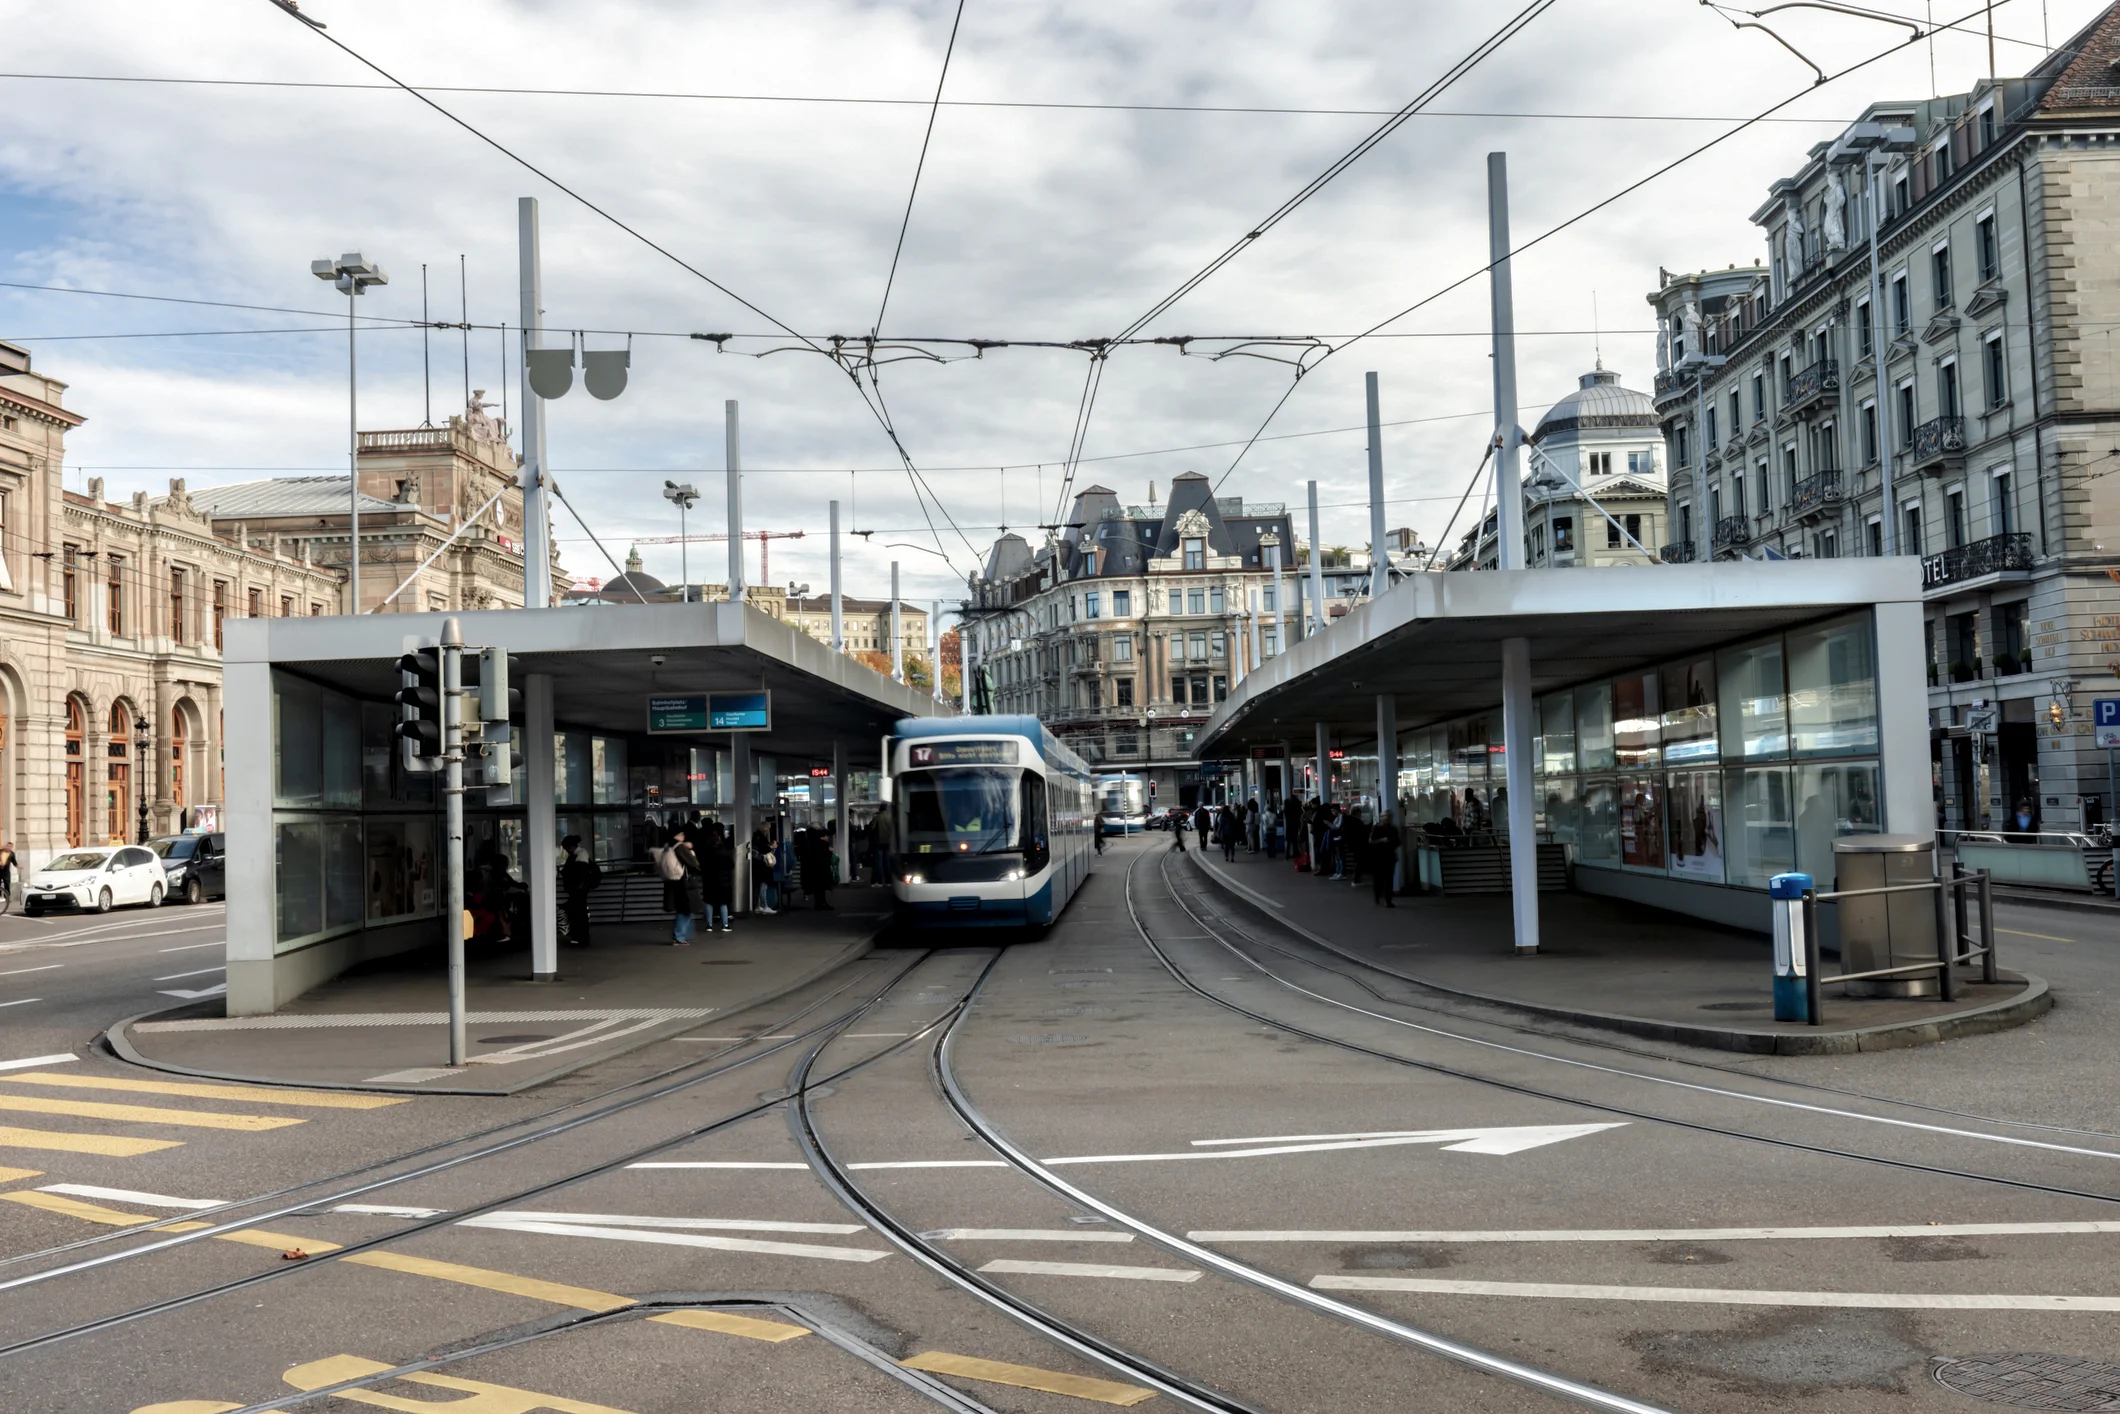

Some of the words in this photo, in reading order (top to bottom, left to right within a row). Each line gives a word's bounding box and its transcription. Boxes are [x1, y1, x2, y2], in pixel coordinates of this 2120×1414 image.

[2102, 702, 2115, 724] P
[658, 718, 665, 727] 3
[715, 717, 724, 725] 14
[915, 748, 932, 761] 17
